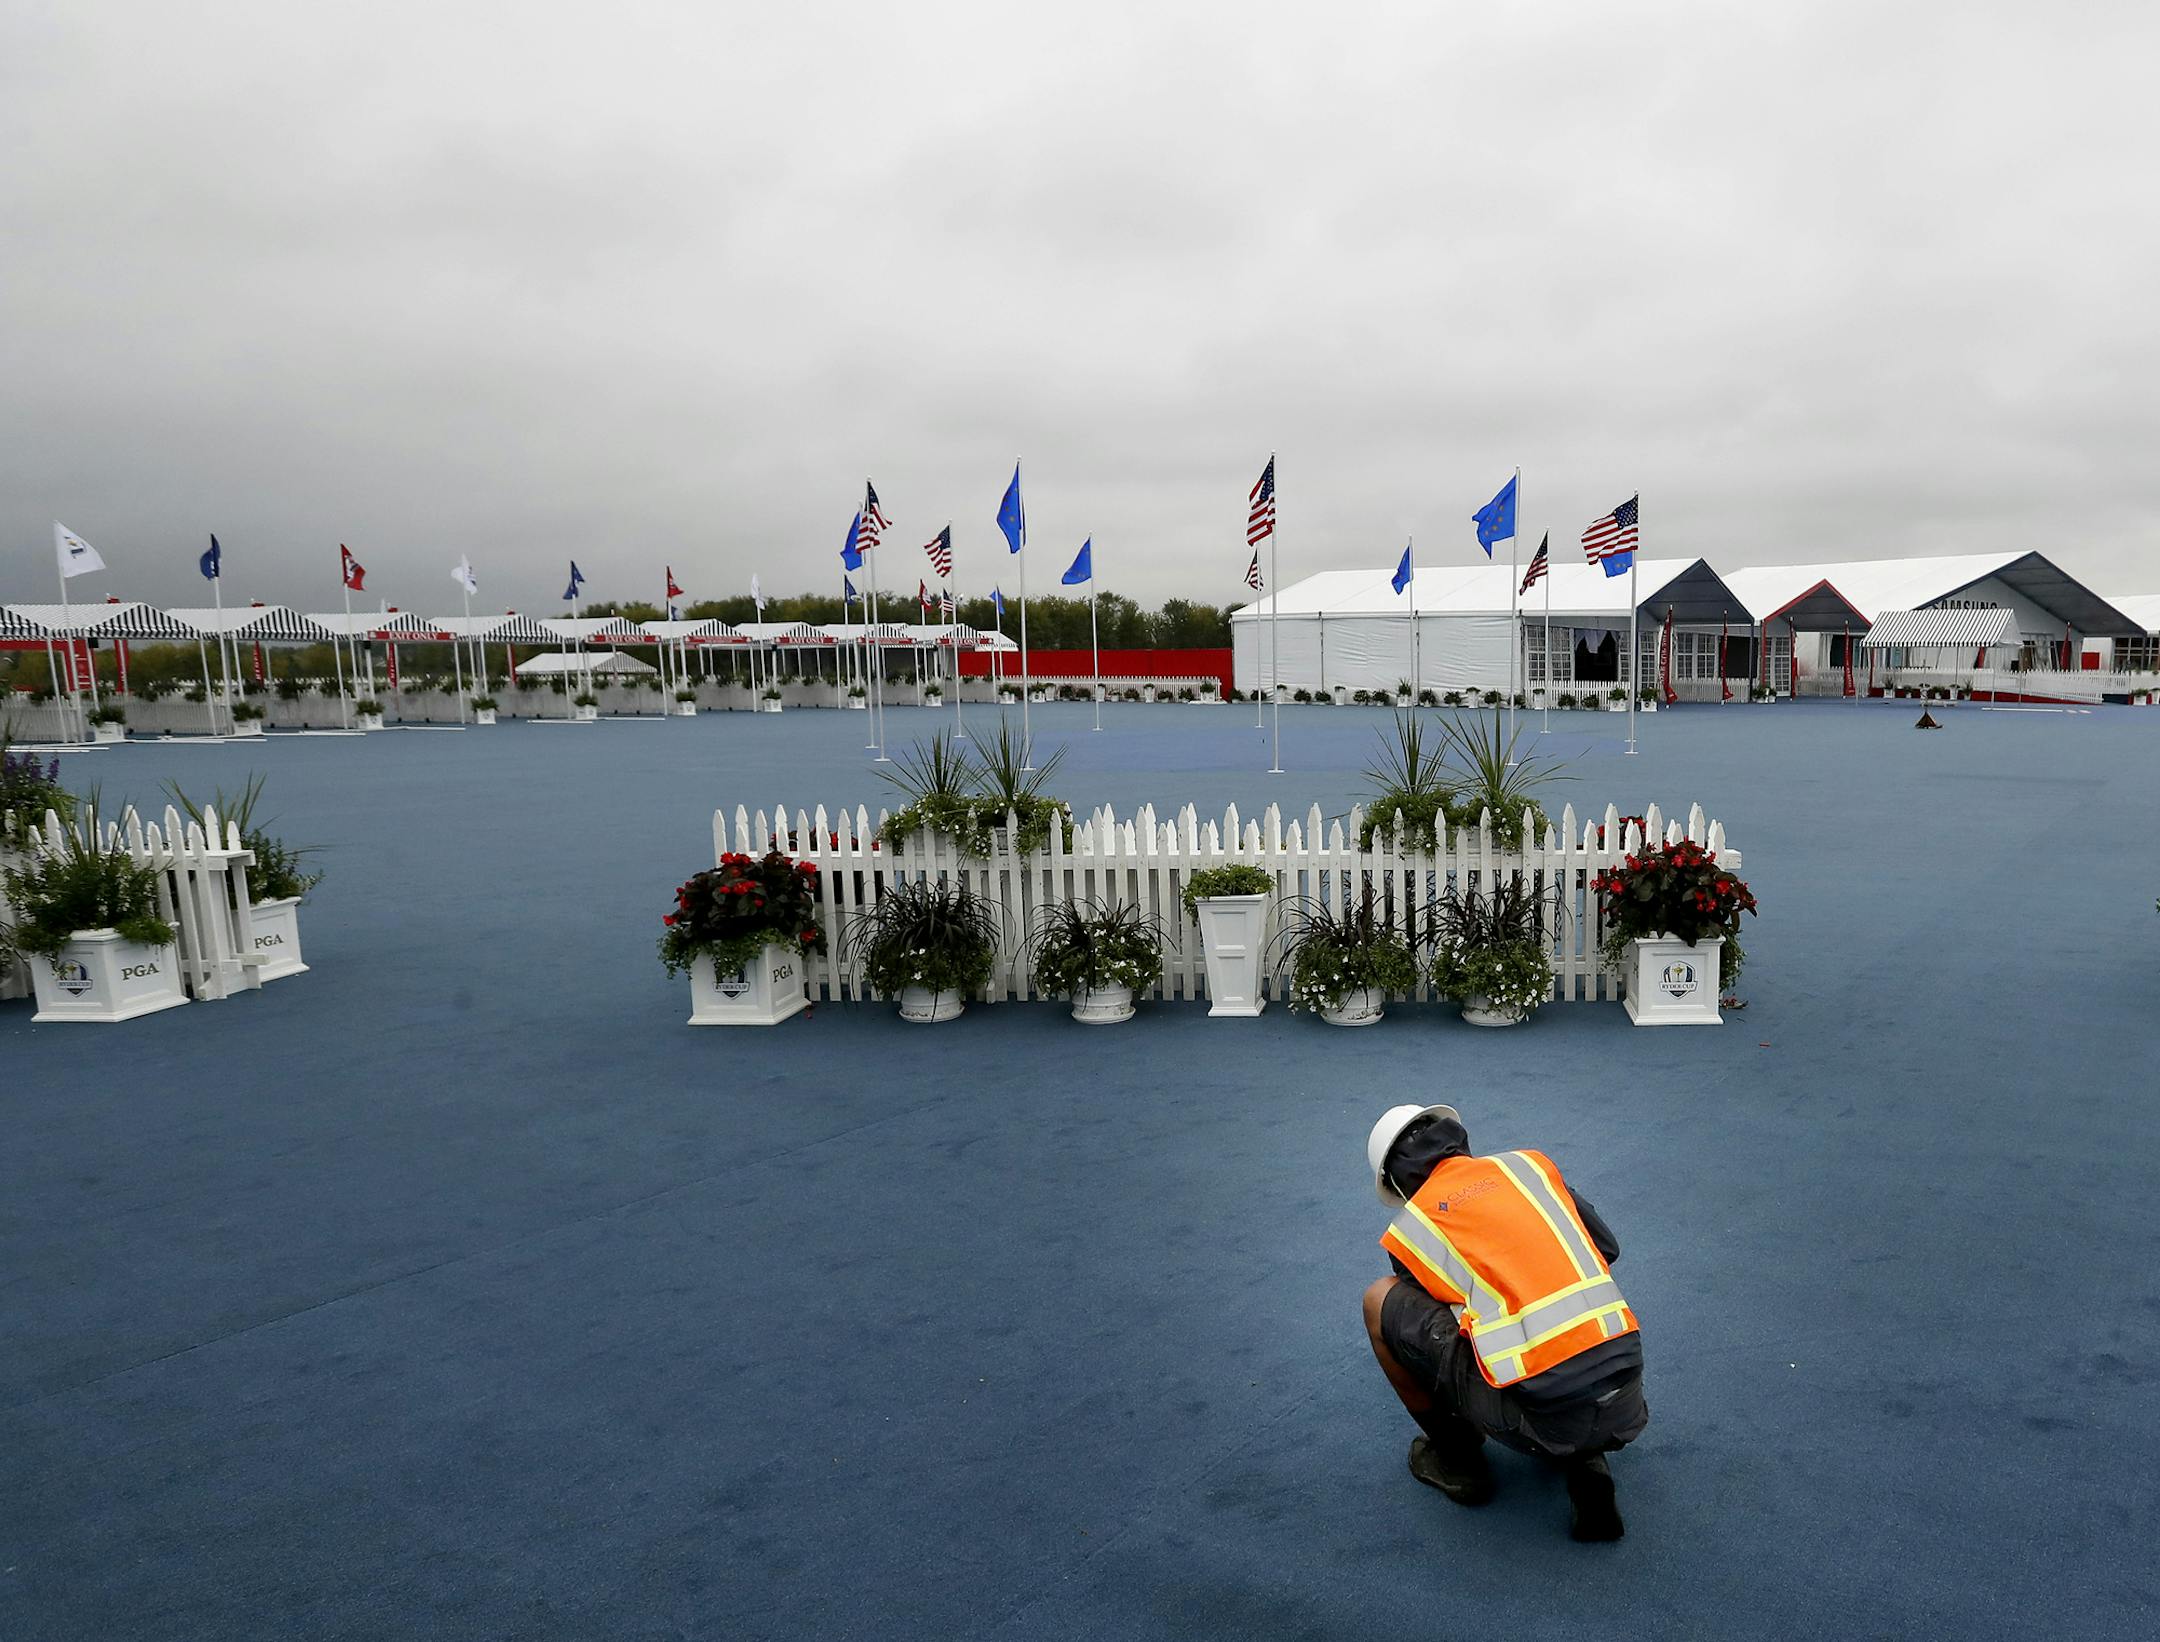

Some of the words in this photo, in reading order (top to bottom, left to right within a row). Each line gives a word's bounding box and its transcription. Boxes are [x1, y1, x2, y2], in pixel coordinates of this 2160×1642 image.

[389, 631, 409, 640] EXIT
[411, 632, 438, 641] ONLY
[254, 934, 284, 949] PGA
[121, 963, 160, 981] PGA
[773, 963, 793, 983] PGA
